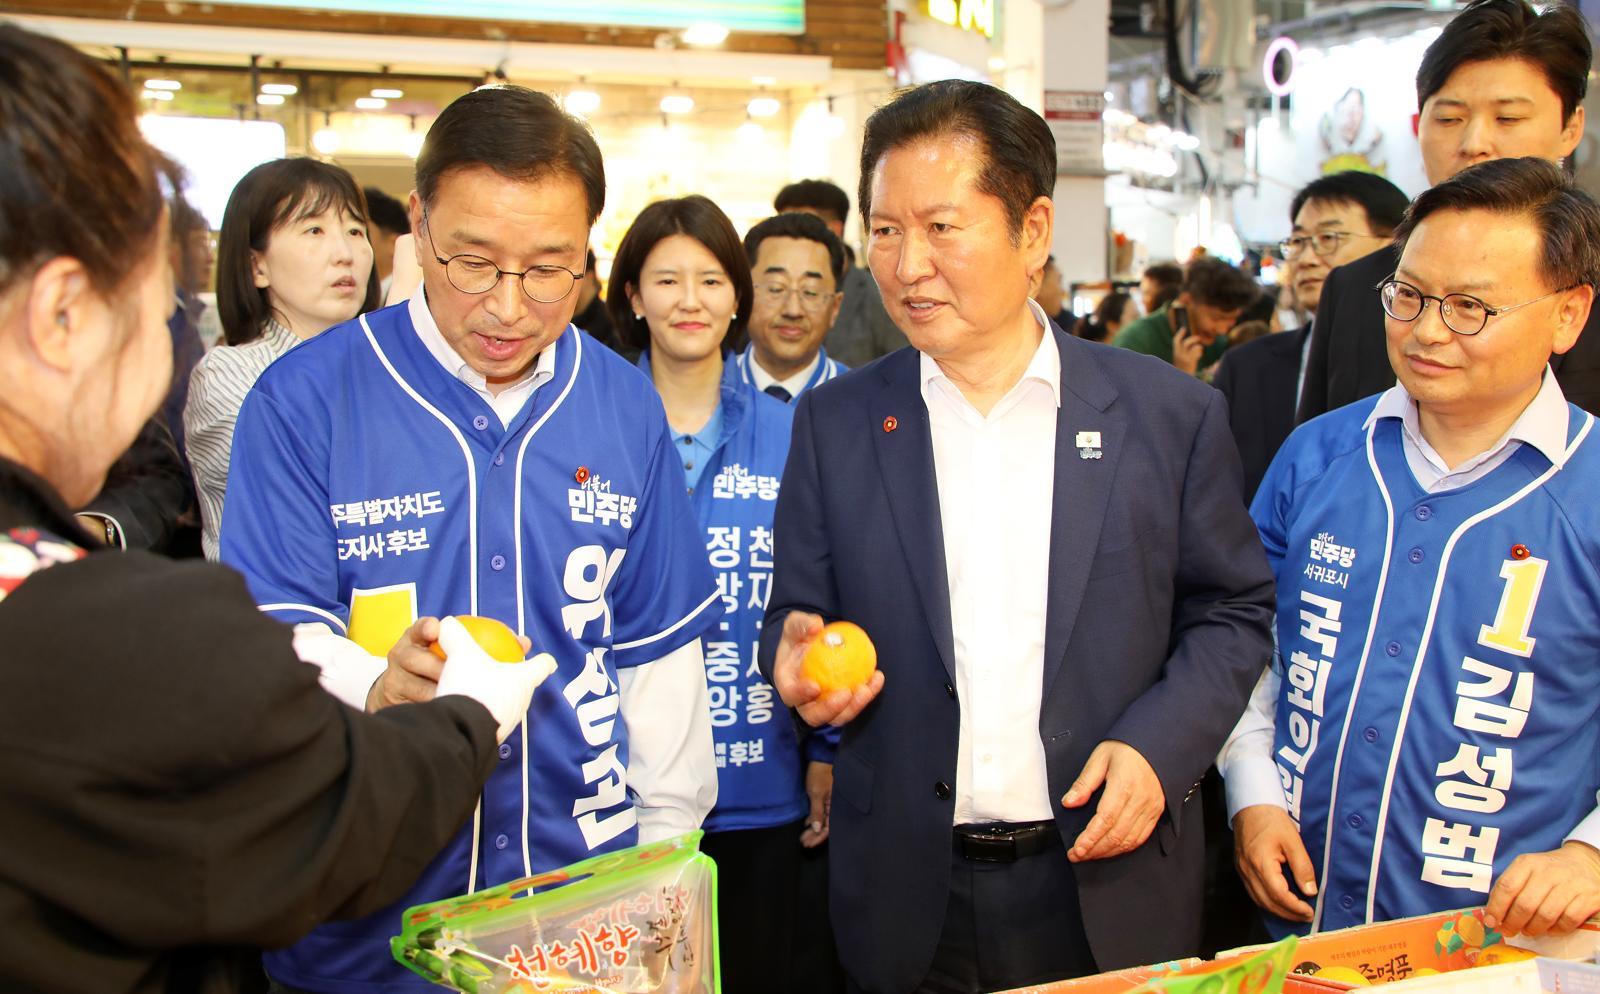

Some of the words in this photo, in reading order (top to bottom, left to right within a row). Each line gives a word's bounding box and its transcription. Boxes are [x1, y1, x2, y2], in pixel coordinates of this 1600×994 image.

[713, 474, 781, 501] 민주당
[568, 488, 638, 529] 민주당
[386, 527, 431, 556] 후보
[1310, 538, 1357, 568] 민주당
[1303, 563, 1349, 590] 서귀포시
[1477, 556, 1549, 658] 1
[729, 738, 765, 767] 후보
[1420, 656, 1535, 894] 김성범
[506, 923, 641, 989] 천혜향
